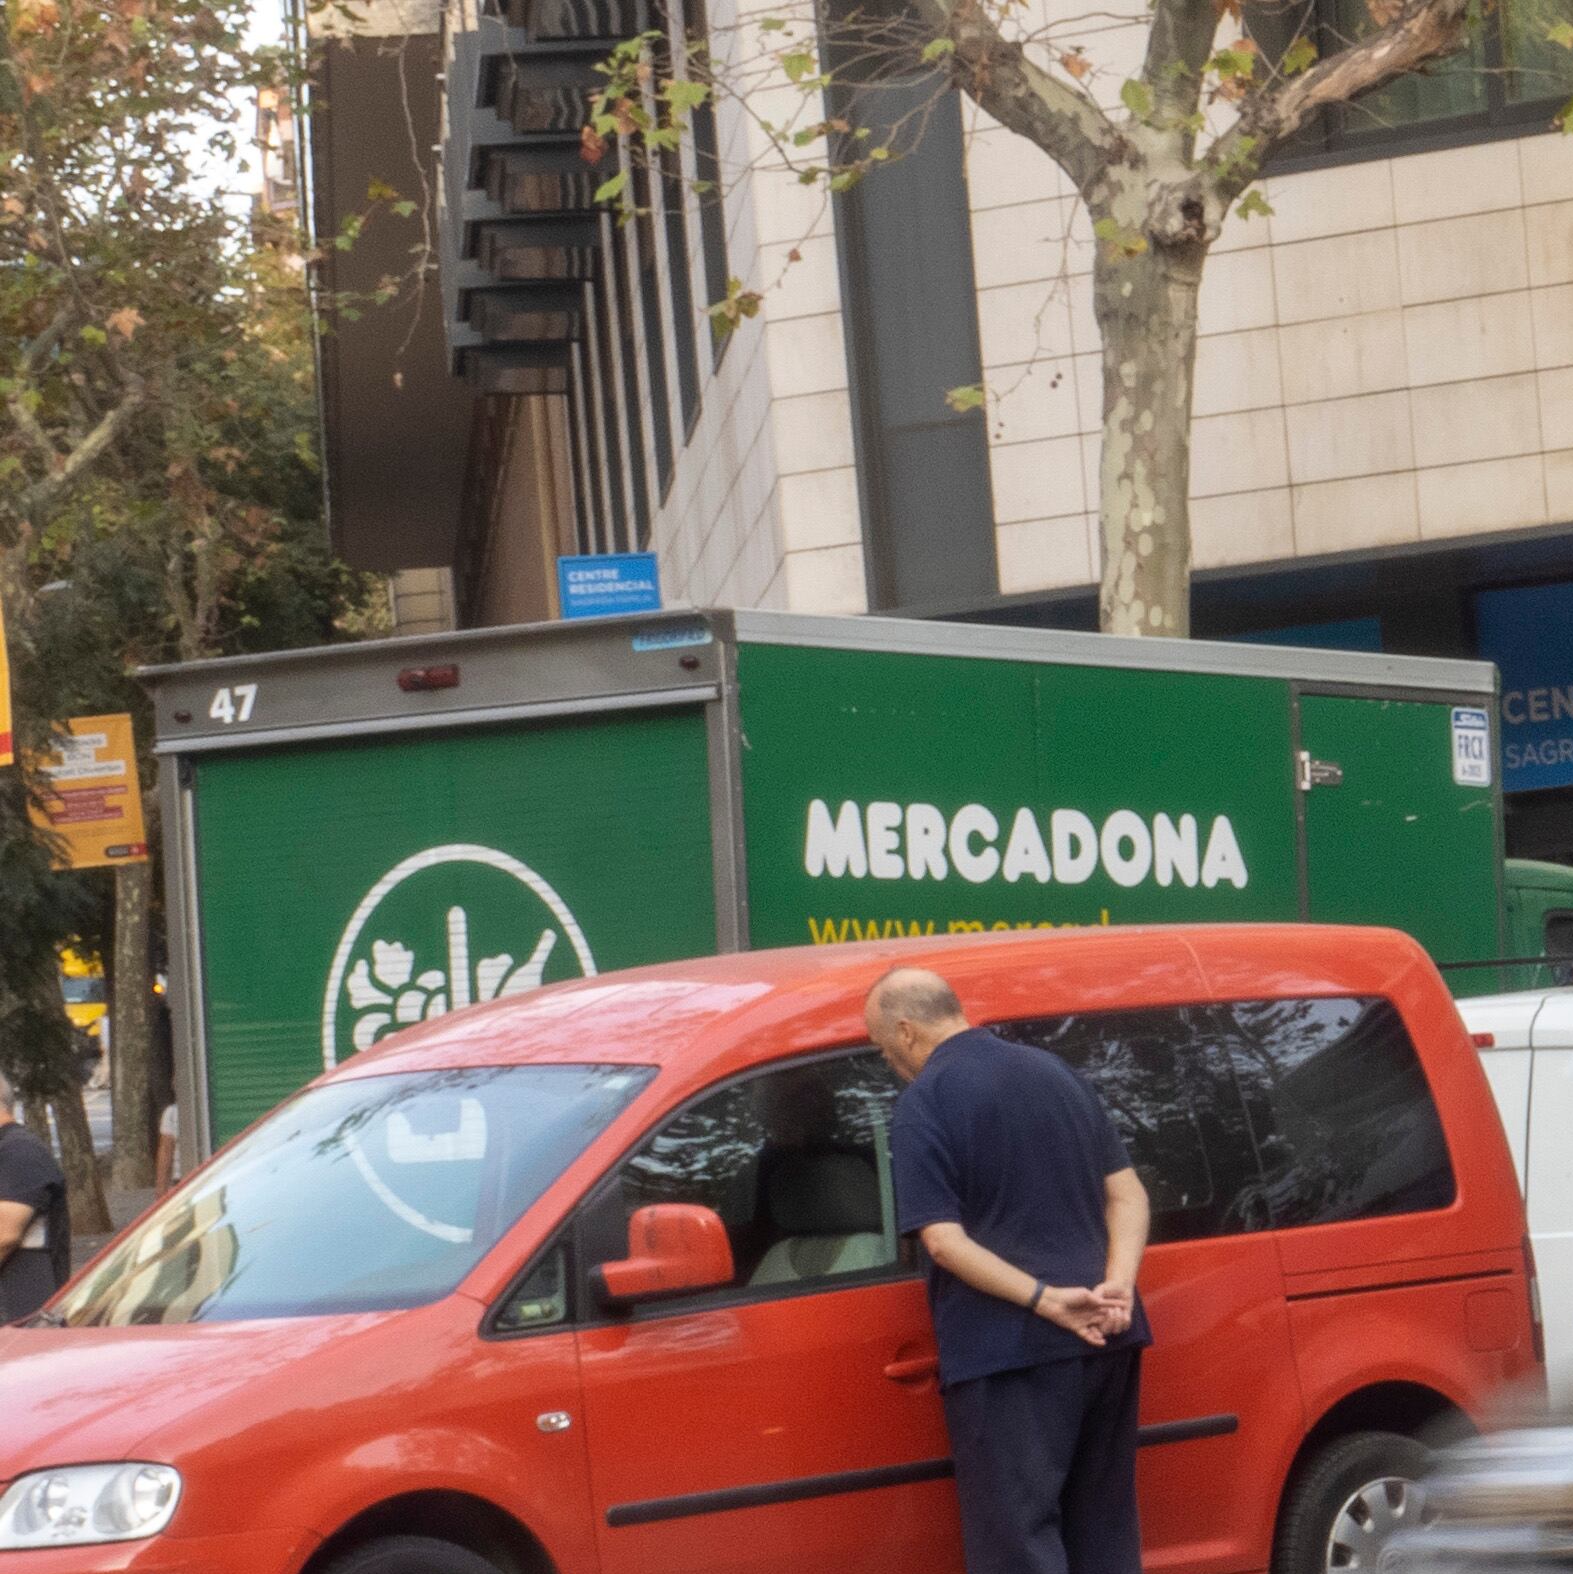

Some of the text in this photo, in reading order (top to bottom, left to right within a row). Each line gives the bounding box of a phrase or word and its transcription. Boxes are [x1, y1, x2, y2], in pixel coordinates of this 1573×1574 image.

[567, 568, 619, 582] CENTRE
[568, 580, 655, 595] RESIDENCIAL
[209, 683, 259, 724] 47
[804, 798, 1249, 889] MERCADONA
